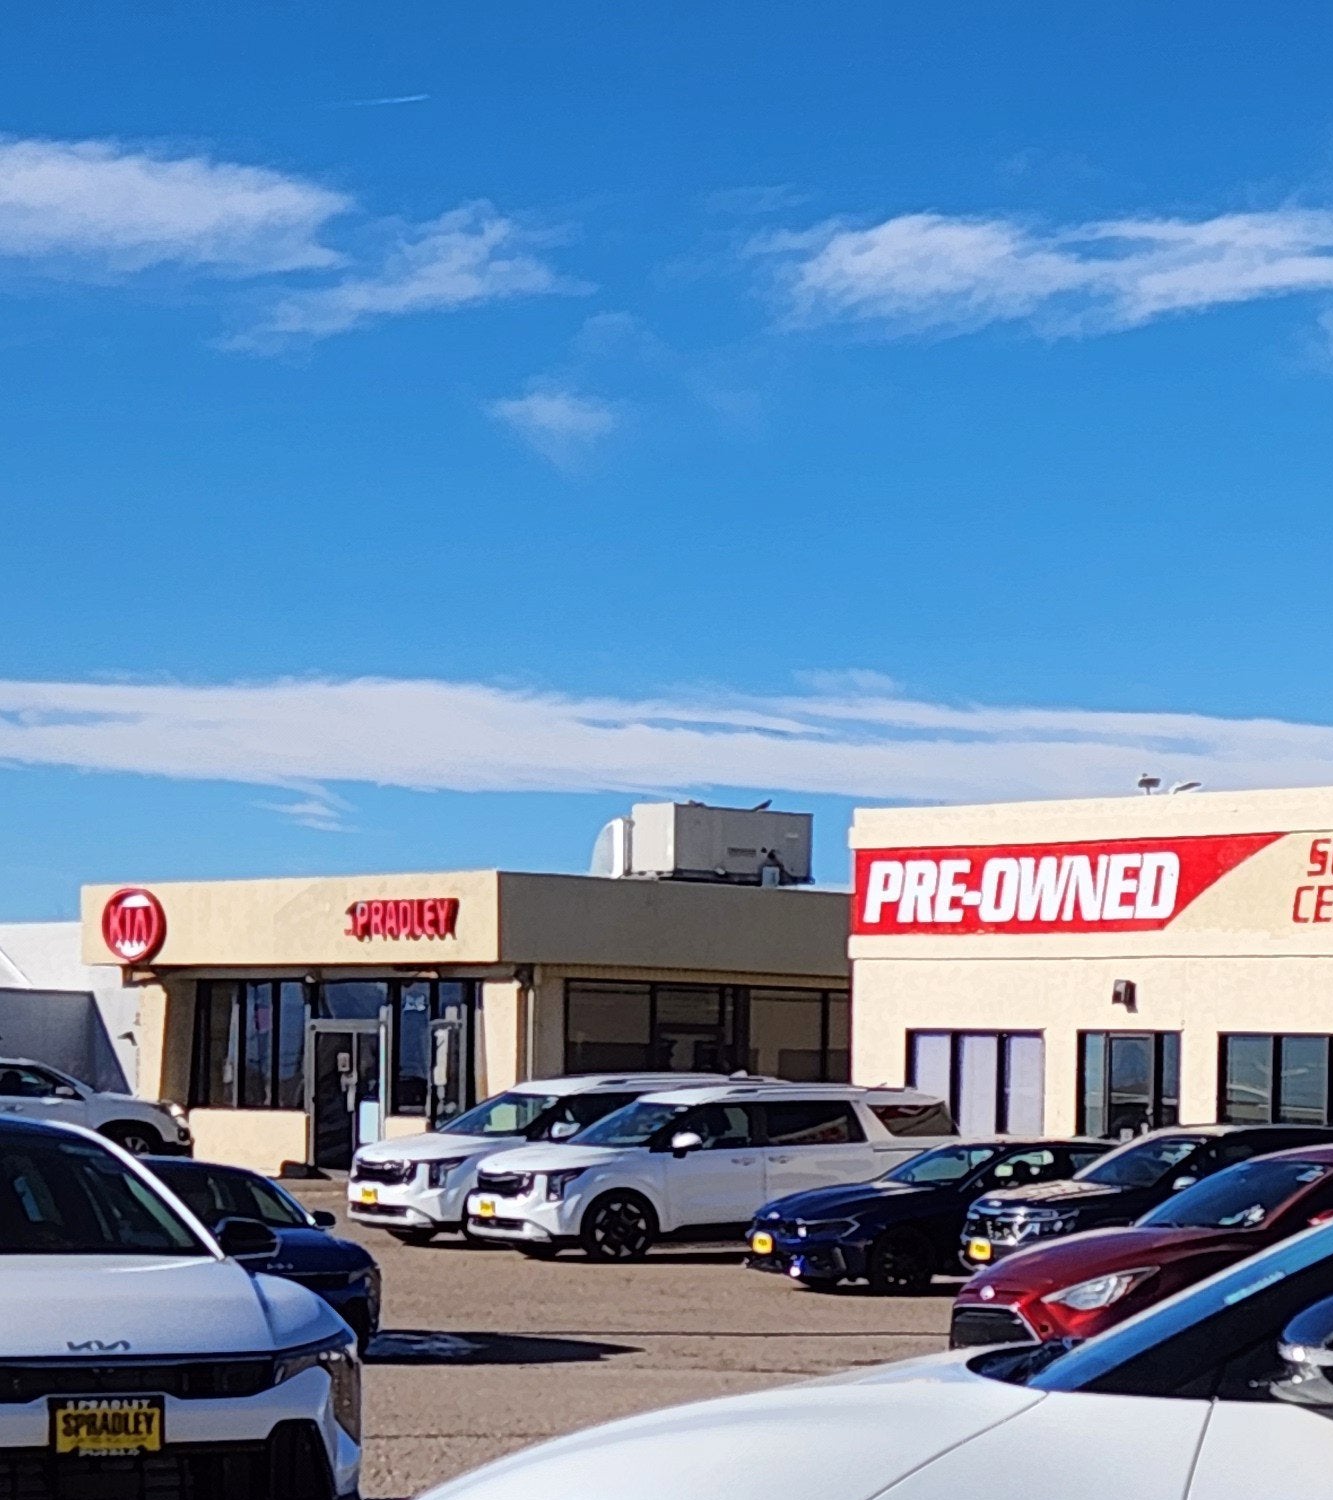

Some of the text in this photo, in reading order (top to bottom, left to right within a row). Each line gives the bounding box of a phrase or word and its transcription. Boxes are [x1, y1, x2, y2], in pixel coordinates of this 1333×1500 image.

[863, 851, 1179, 923] PRE-OWNED
[109, 904, 147, 943] KIA
[62, 1411, 155, 1437] SPRADLEY
